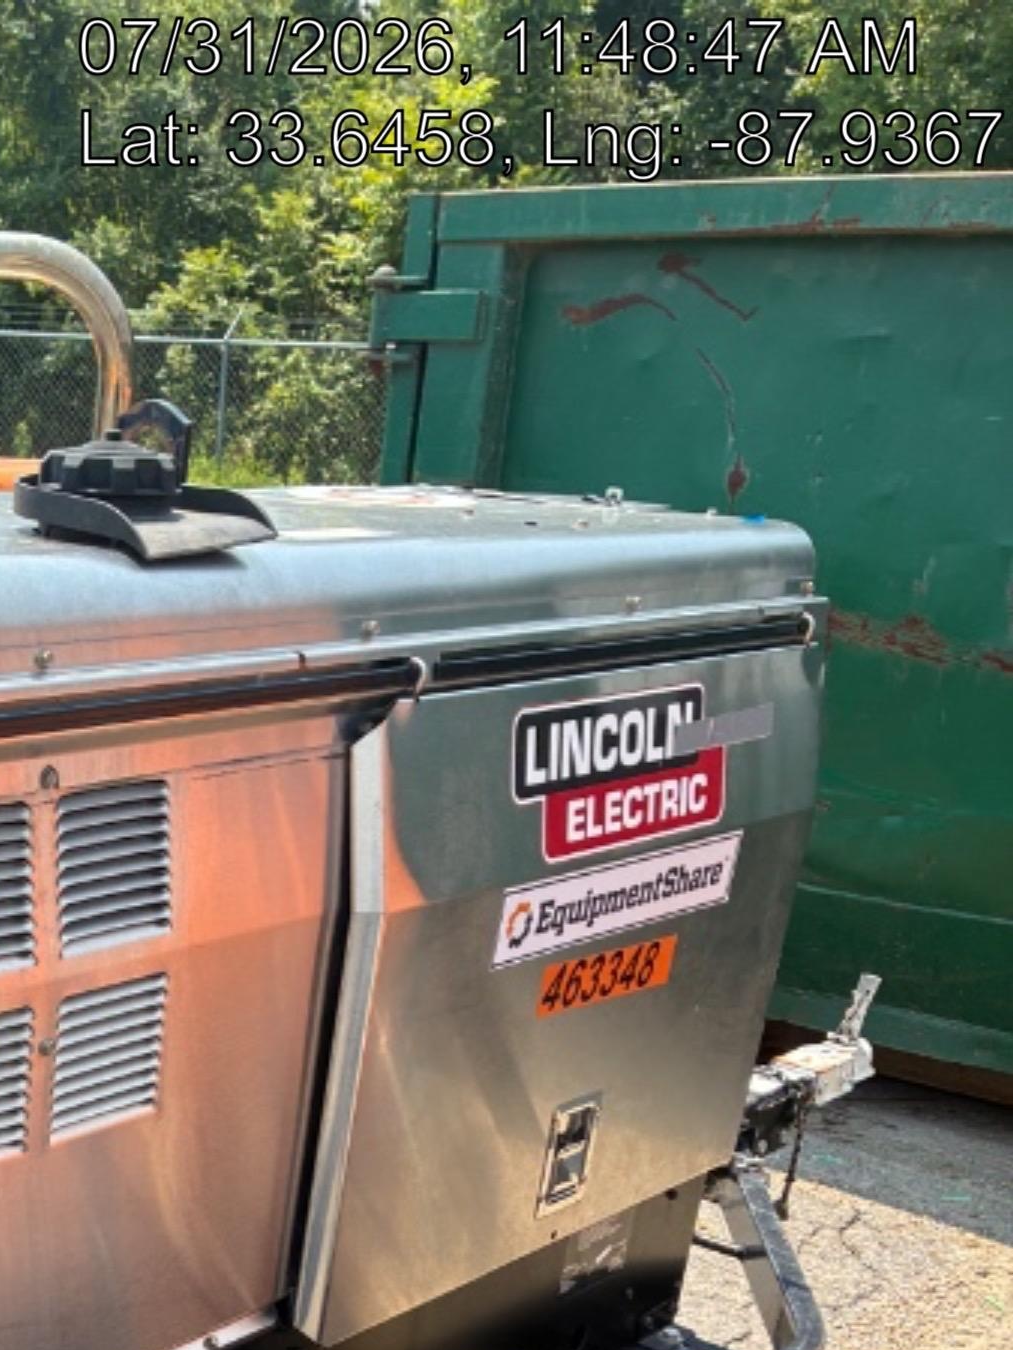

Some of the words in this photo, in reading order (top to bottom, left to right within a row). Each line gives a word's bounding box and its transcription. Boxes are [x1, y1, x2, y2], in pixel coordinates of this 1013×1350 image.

[525, 702, 694, 787] LINCOLN
[565, 773, 708, 844] ELECTRIC
[534, 861, 725, 938] EquipmentShare
[541, 941, 661, 1013] 463348
